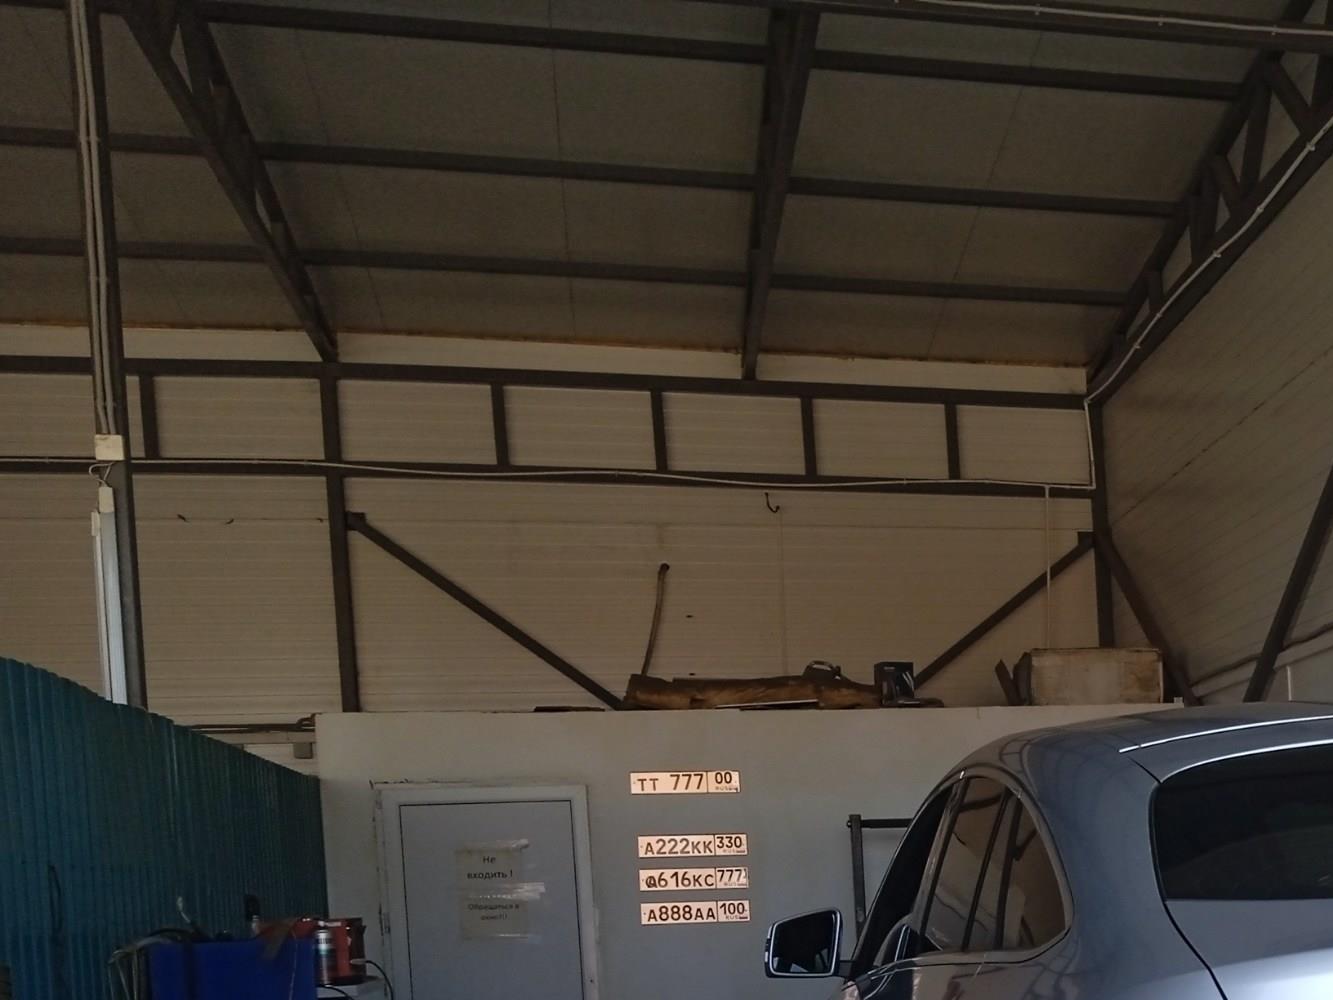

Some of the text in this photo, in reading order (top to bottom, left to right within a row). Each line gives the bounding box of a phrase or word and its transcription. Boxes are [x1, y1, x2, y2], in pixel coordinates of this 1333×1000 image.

[637, 771, 733, 792] ТТ 777 00
[644, 836, 743, 855] А222КК 330
[647, 902, 745, 922] А888АА 100
